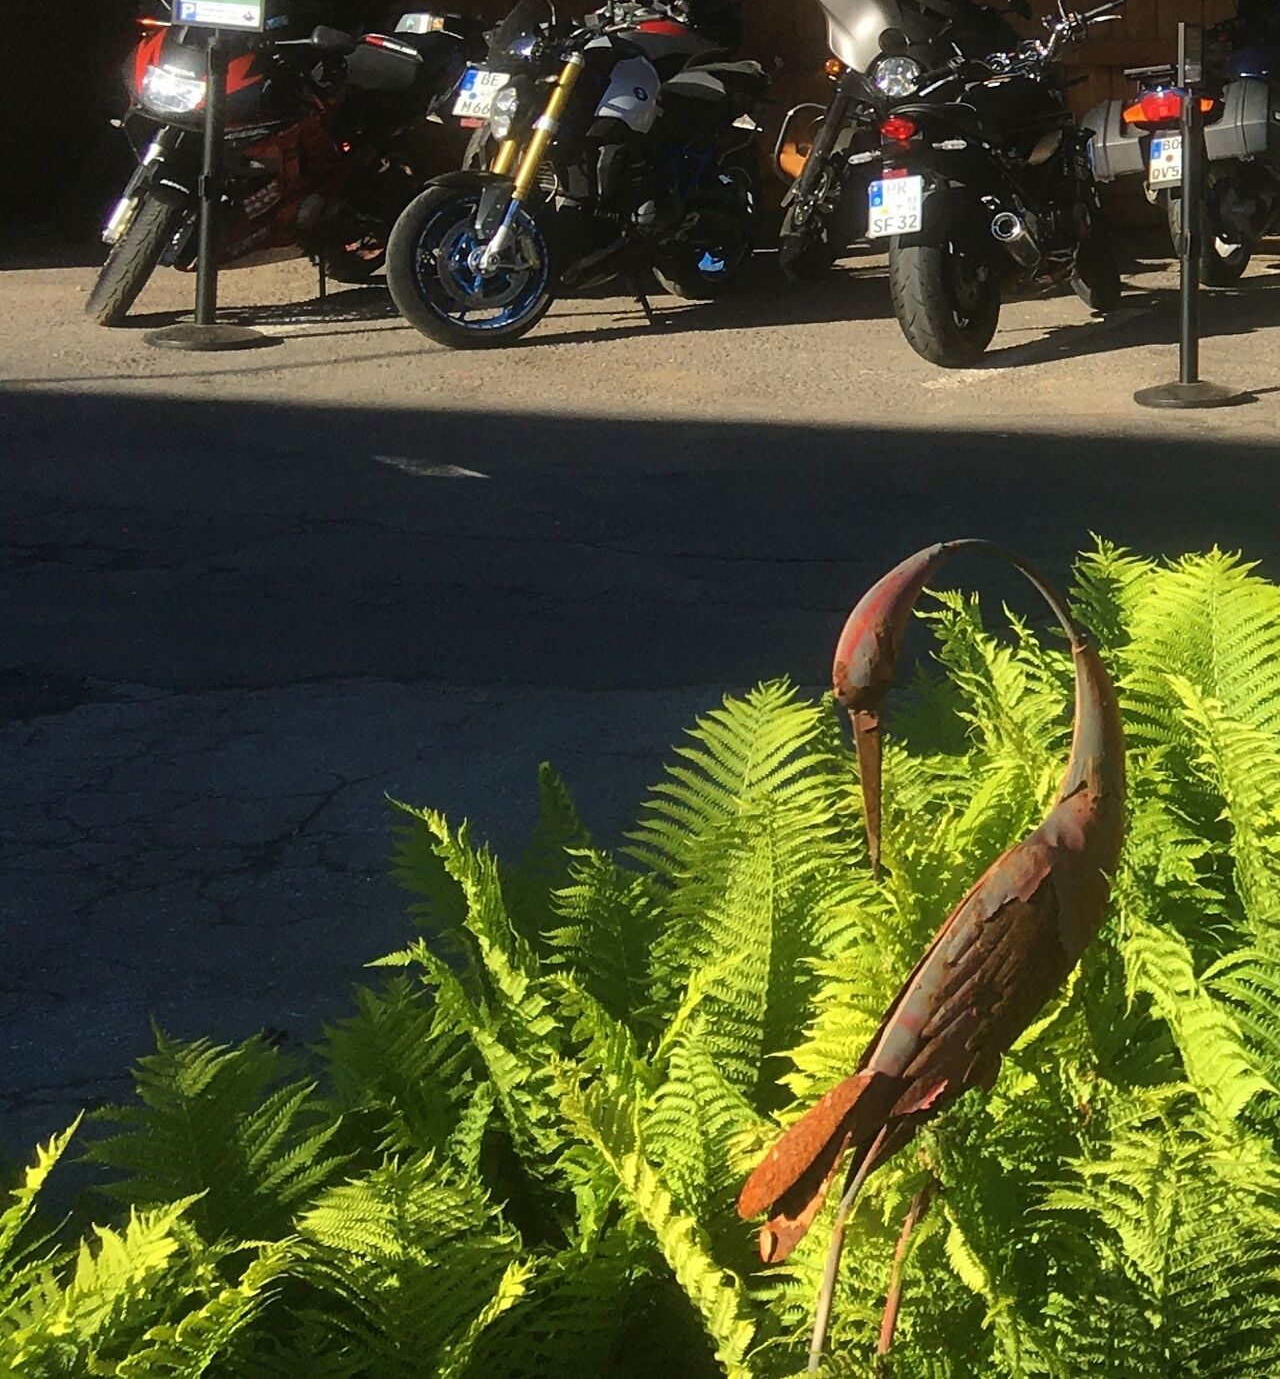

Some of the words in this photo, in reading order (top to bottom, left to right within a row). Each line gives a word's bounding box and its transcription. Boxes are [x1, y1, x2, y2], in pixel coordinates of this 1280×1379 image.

[181, 3, 195, 20] P
[481, 74, 499, 86] BE
[873, 217, 894, 233] SF
[897, 214, 918, 230] 32
